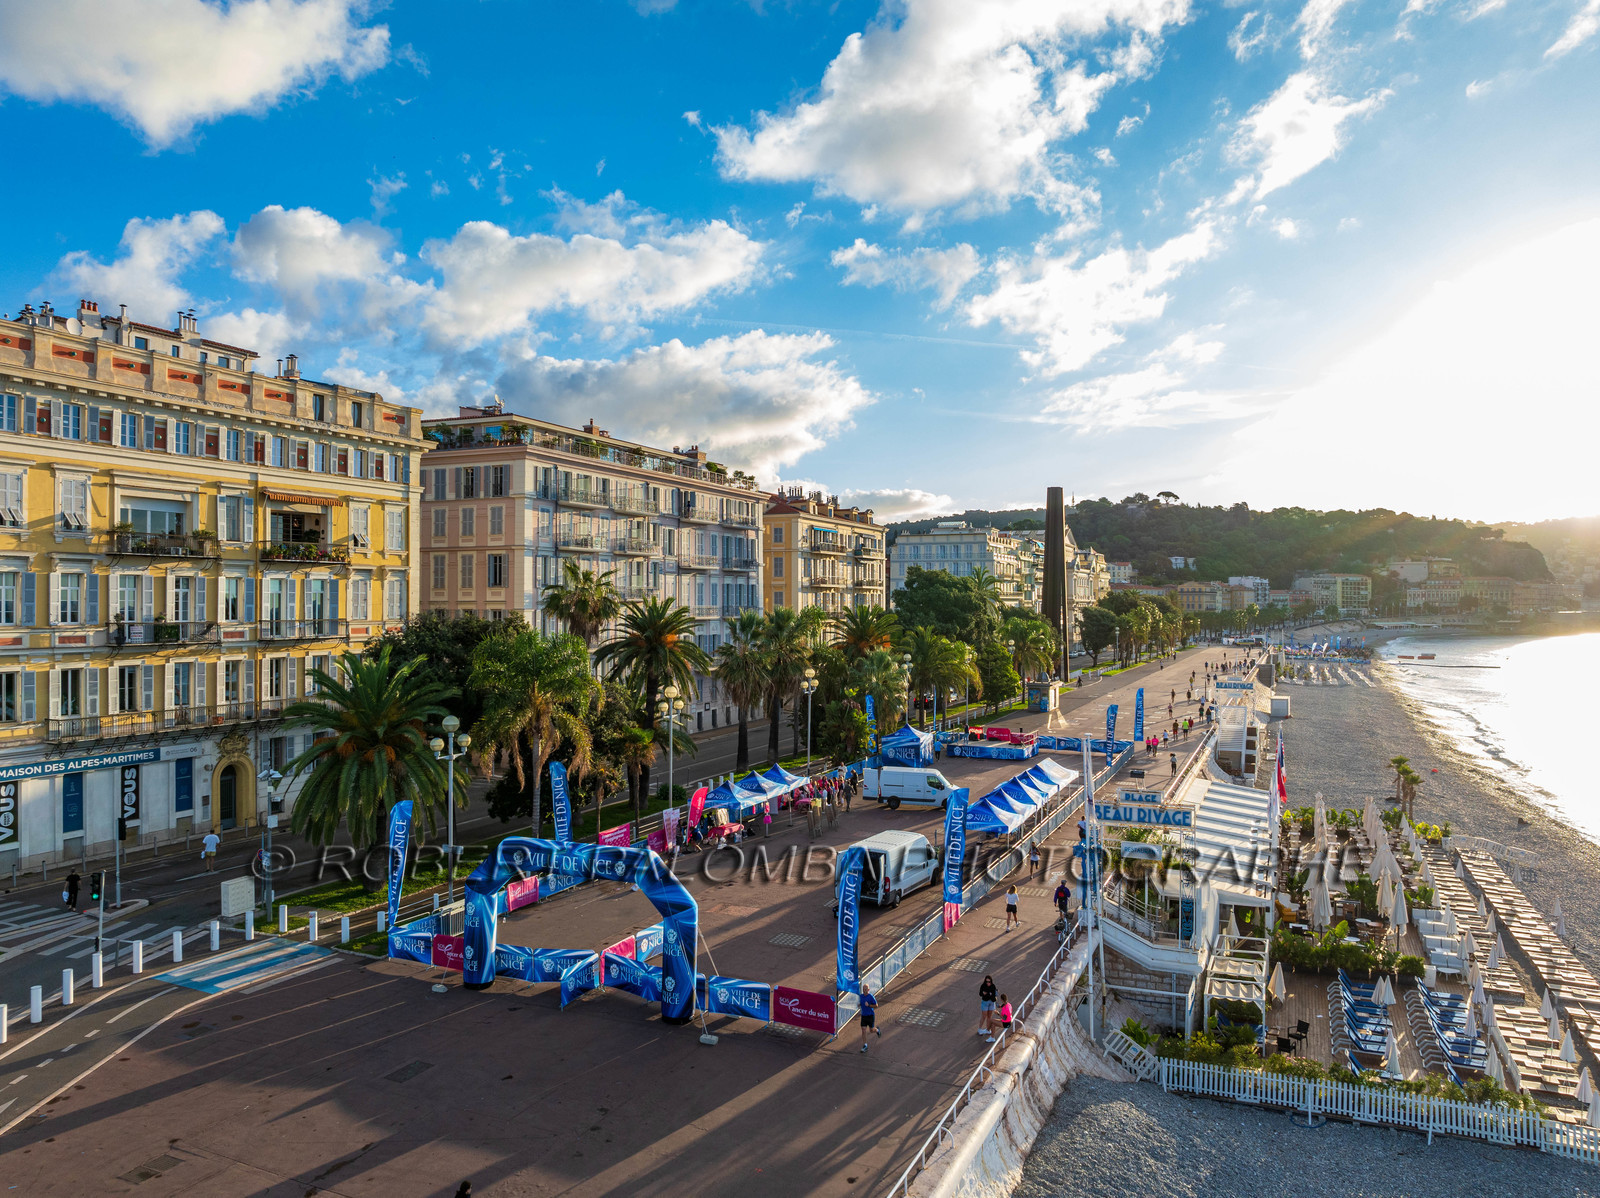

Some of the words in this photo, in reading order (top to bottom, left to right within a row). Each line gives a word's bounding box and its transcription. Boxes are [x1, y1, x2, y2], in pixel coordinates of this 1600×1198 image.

[0, 765, 42, 778] MAISON
[45, 762, 66, 773] DES
[67, 751, 155, 770] ALPES-MARITIMES
[553, 775, 565, 799] NICE
[555, 801, 567, 815] DE
[1094, 804, 1133, 822] BEAU
[1137, 807, 1192, 827] RIVAGE
[951, 804, 964, 833] NICE
[395, 819, 407, 849] NICE
[557, 816, 568, 842] VILLE
[950, 835, 962, 851] DE
[528, 852, 558, 870] VILLE
[562, 855, 579, 872] DE
[581, 858, 612, 875] NICE
[948, 854, 961, 882] VILLE
[557, 875, 574, 889] NICE
[845, 868, 859, 905] NICE
[843, 907, 855, 928] DE
[404, 943, 425, 955] NICE
[648, 936, 663, 950] NIC
[843, 930, 854, 966] VILLE
[663, 948, 682, 957] NICE
[500, 960, 525, 971] NICE
[620, 965, 634, 974] VILLE
[576, 971, 595, 987] NICE
[620, 973, 643, 987] NICE
[663, 996, 680, 1005] NICE
[731, 989, 750, 998] VILLE
[731, 995, 761, 1009] NICE
[808, 1008, 817, 1016] du
[817, 1010, 830, 1019] sein
